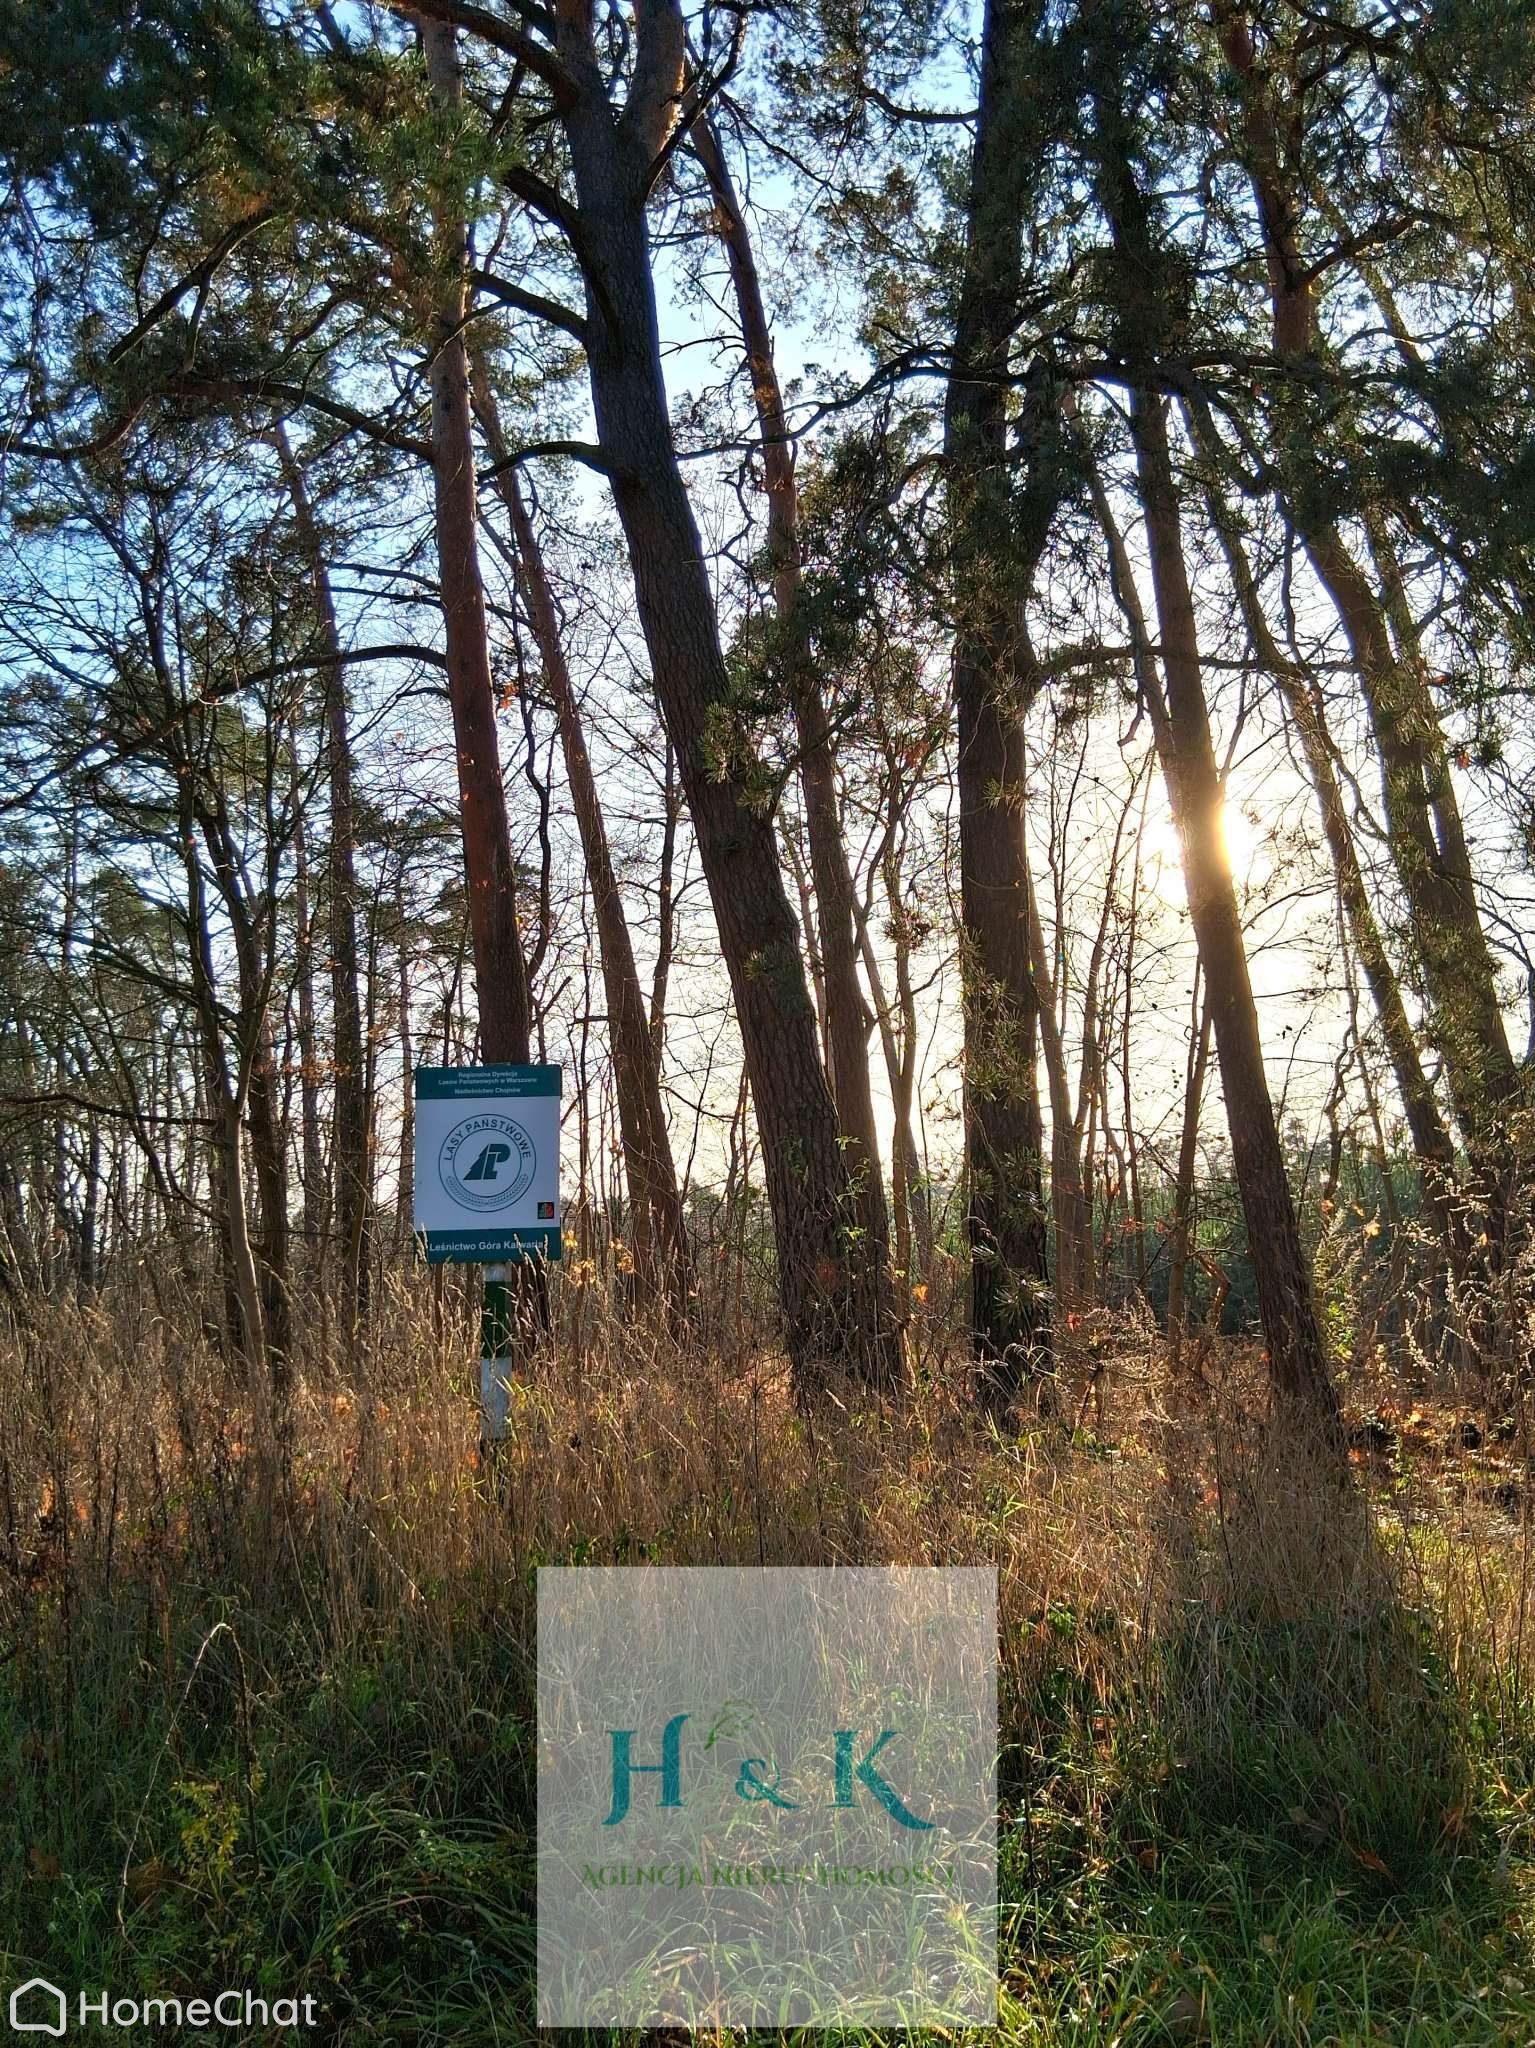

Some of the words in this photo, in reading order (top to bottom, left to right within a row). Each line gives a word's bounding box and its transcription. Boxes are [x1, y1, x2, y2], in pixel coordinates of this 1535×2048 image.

[443, 1130, 464, 1161] LASY
[429, 1240, 476, 1251] Leśnictwo
[479, 1240, 501, 1250] Góra
